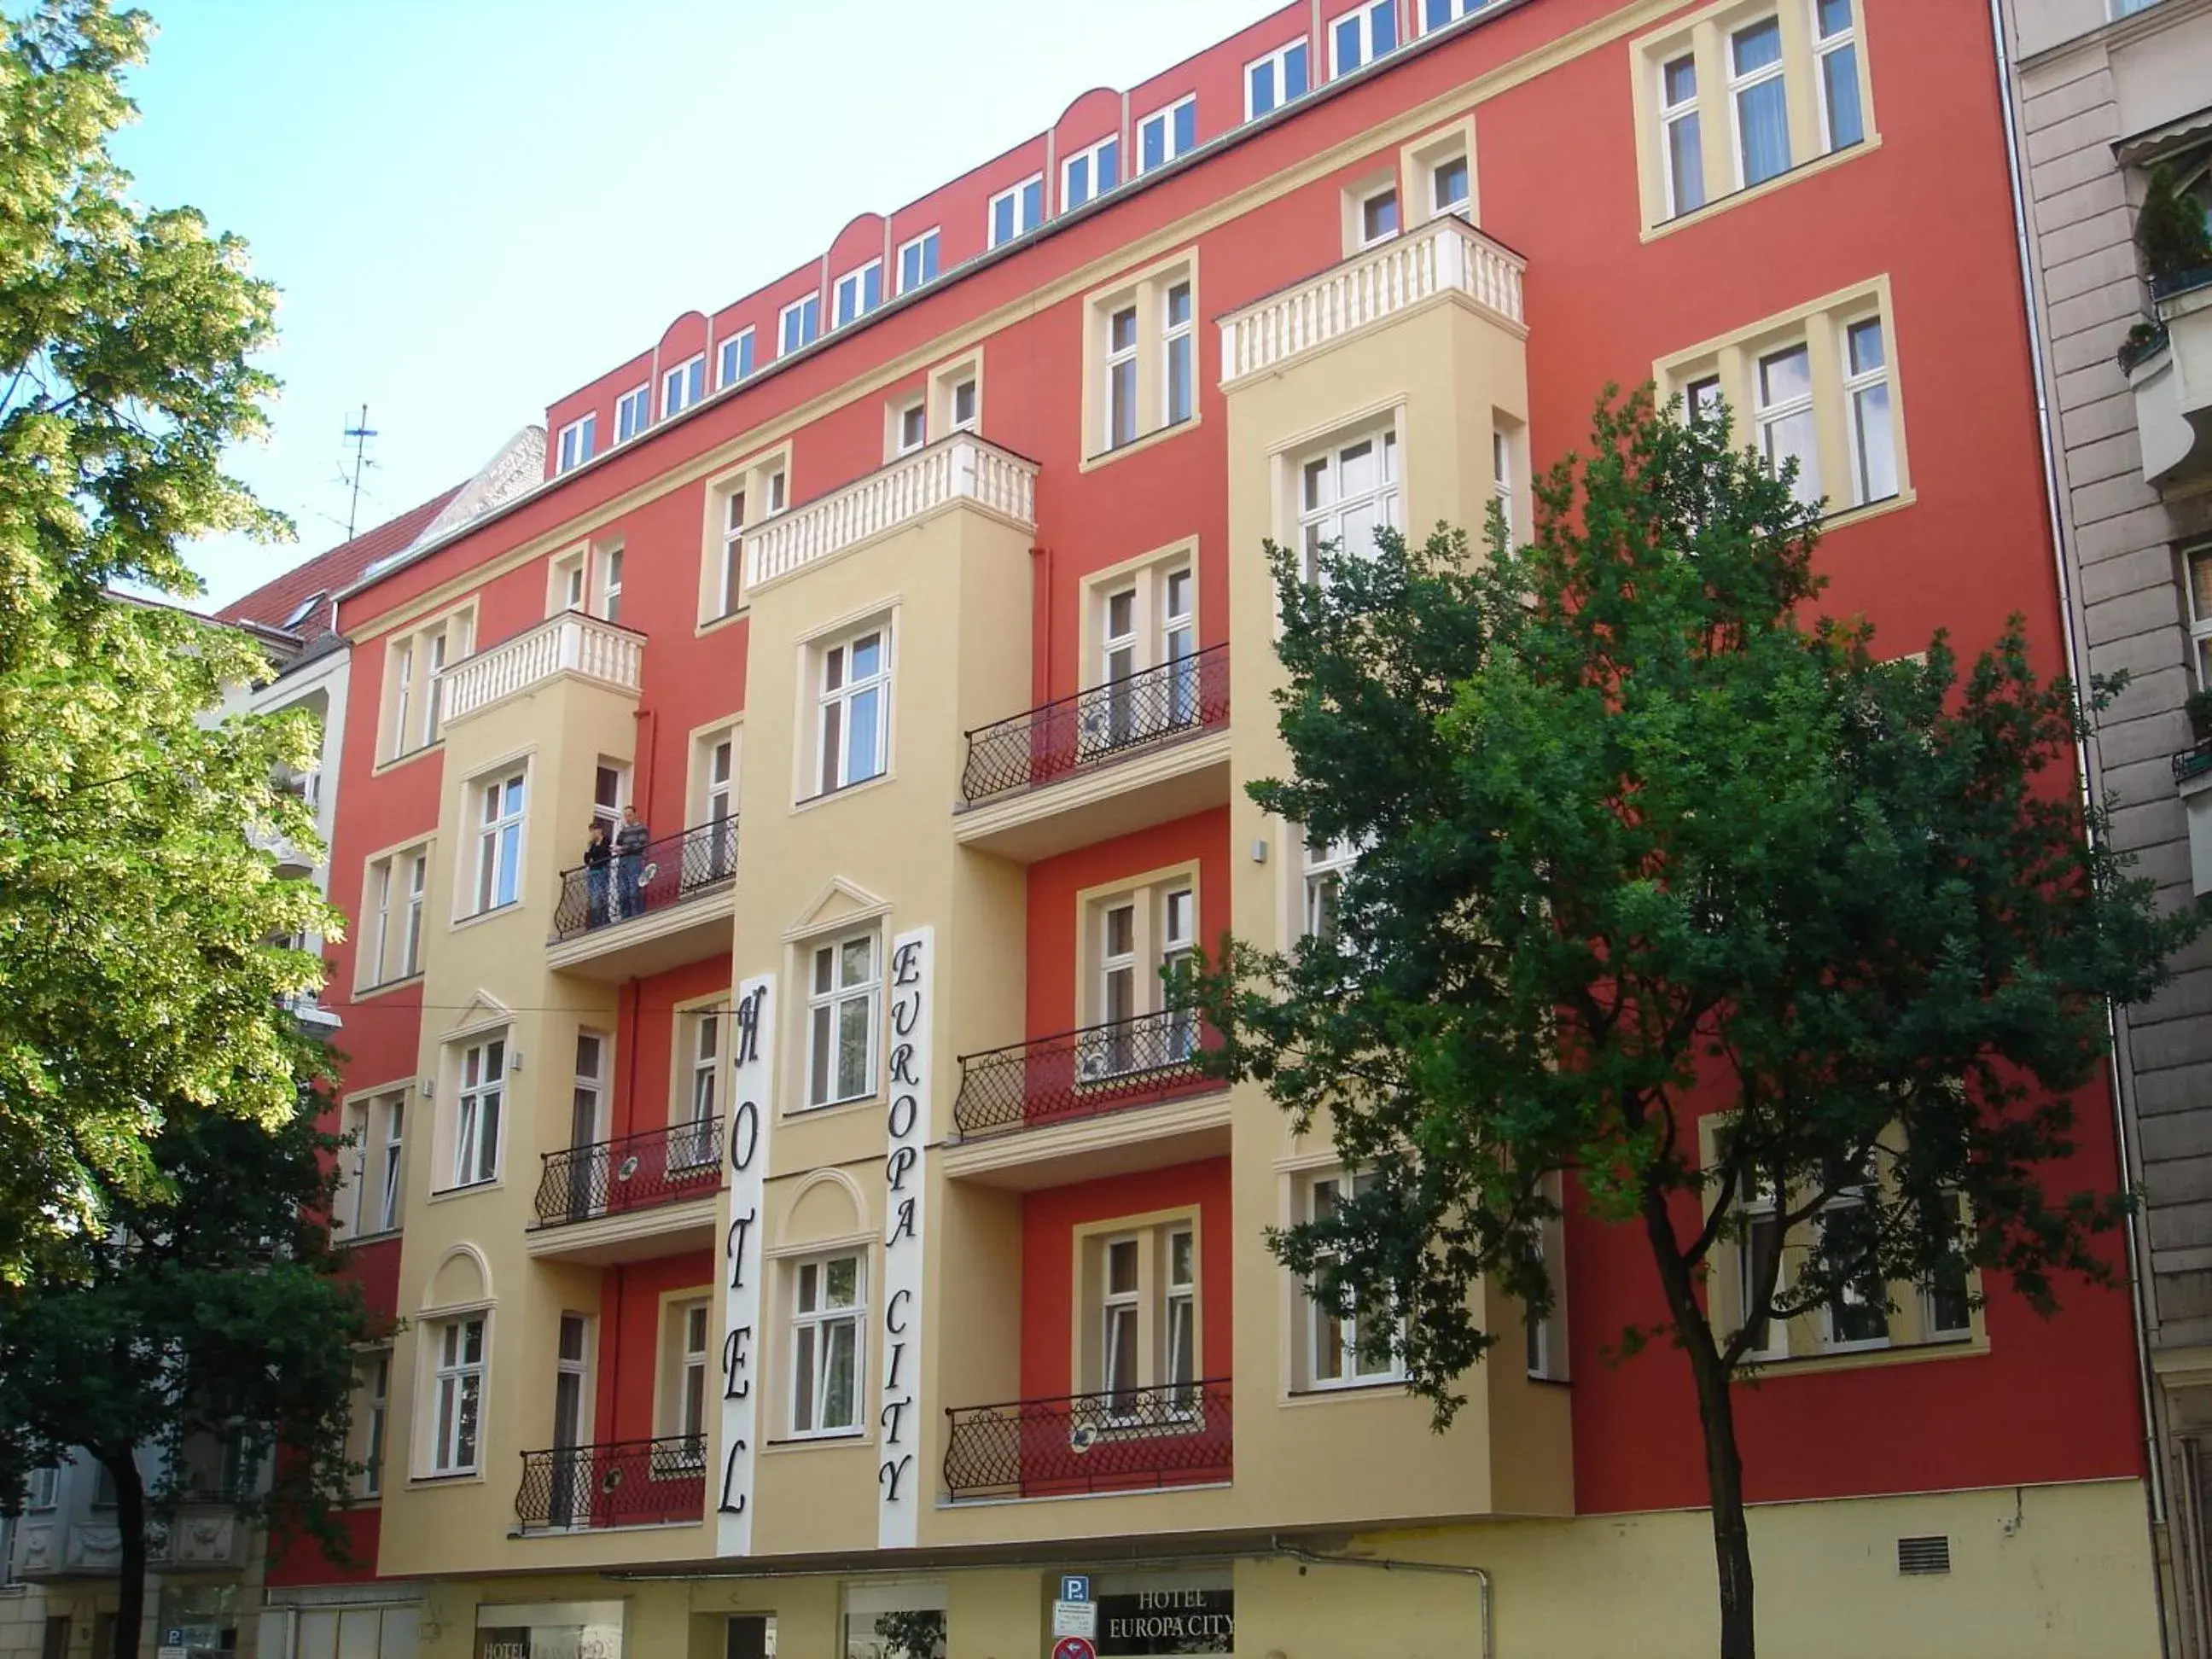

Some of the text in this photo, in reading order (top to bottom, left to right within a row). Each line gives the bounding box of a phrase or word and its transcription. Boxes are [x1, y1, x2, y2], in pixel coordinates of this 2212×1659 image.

[878, 940, 923, 1501] EUROPA CITY
[718, 984, 767, 1514] HOTEL
[1068, 1580, 1082, 1599] P
[1138, 1588, 1208, 1610] HOTEL
[1109, 1616, 1185, 1639] EUROPA
[1187, 1614, 1236, 1636] CITY
[483, 1642, 527, 1659] HOTEL
